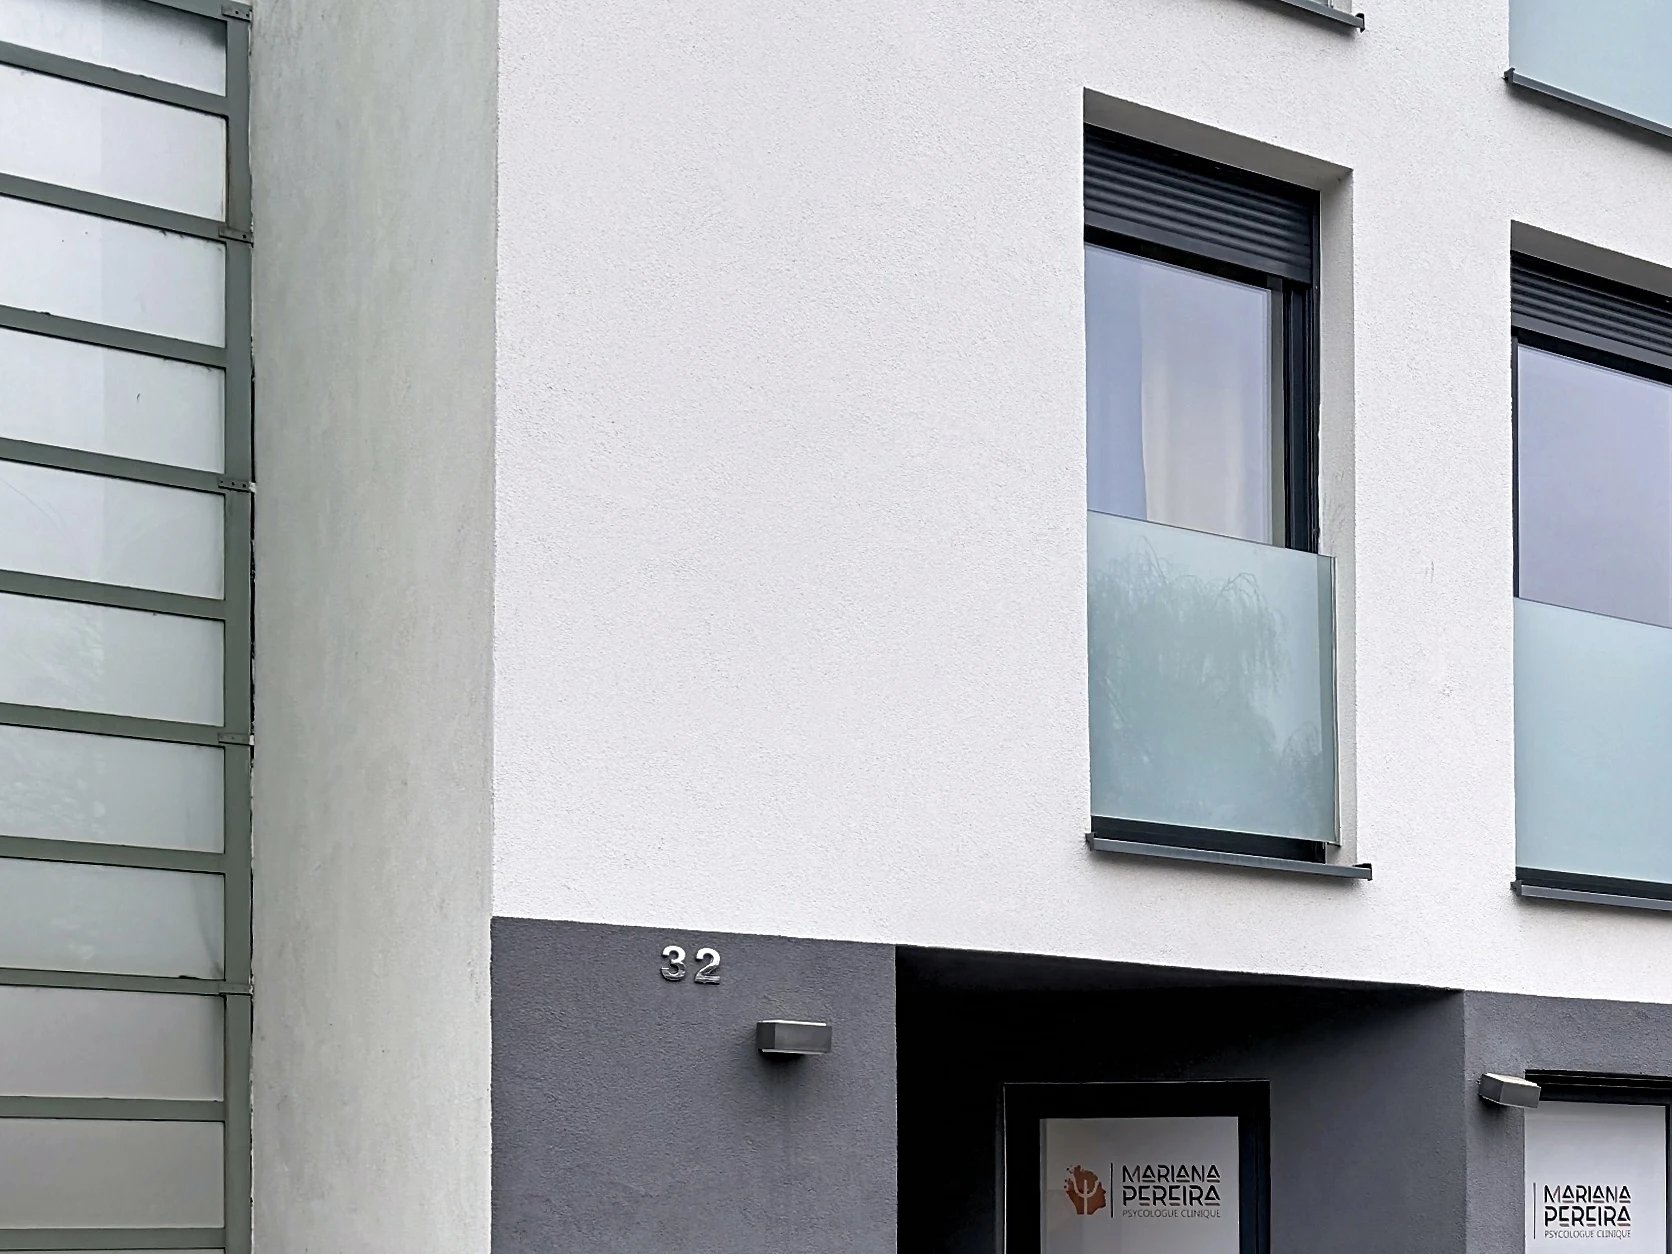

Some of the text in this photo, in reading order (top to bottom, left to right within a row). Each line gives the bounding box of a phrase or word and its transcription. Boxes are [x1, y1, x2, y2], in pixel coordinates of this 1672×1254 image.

[660, 945, 722, 985] 32
[1122, 1164, 1221, 1183] MARIANA
[1122, 1185, 1221, 1206] PEREIRA
[1544, 1185, 1631, 1203] MARIANA
[1122, 1209, 1221, 1219] PSYCOLOGUE CLINIQUE
[1544, 1206, 1631, 1227] PEREIRA
[1544, 1229, 1631, 1239] PSYCOLOGUE CLINIQUE
